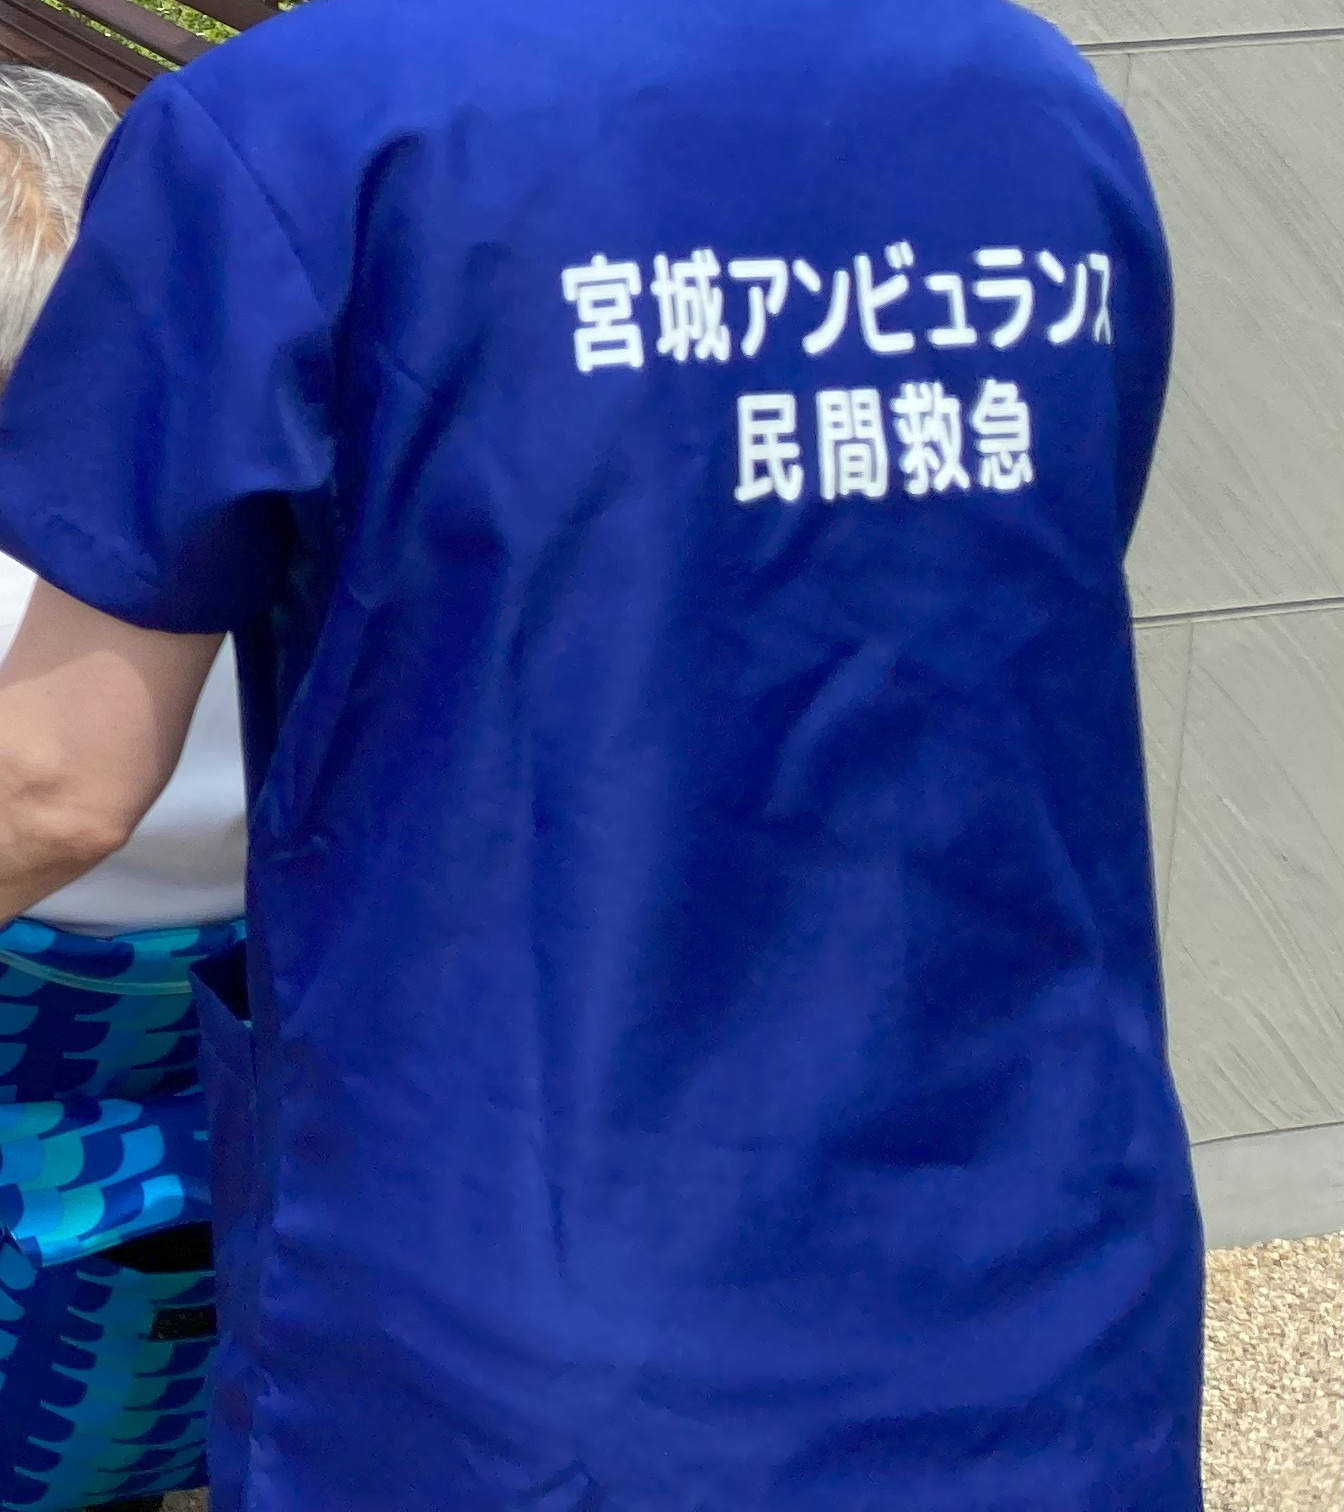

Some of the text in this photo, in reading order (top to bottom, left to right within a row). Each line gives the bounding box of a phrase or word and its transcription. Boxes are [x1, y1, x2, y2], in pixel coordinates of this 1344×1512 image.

[561, 241, 1112, 374] 宮城アンビュランス
[734, 378, 1034, 503] 民間救急
